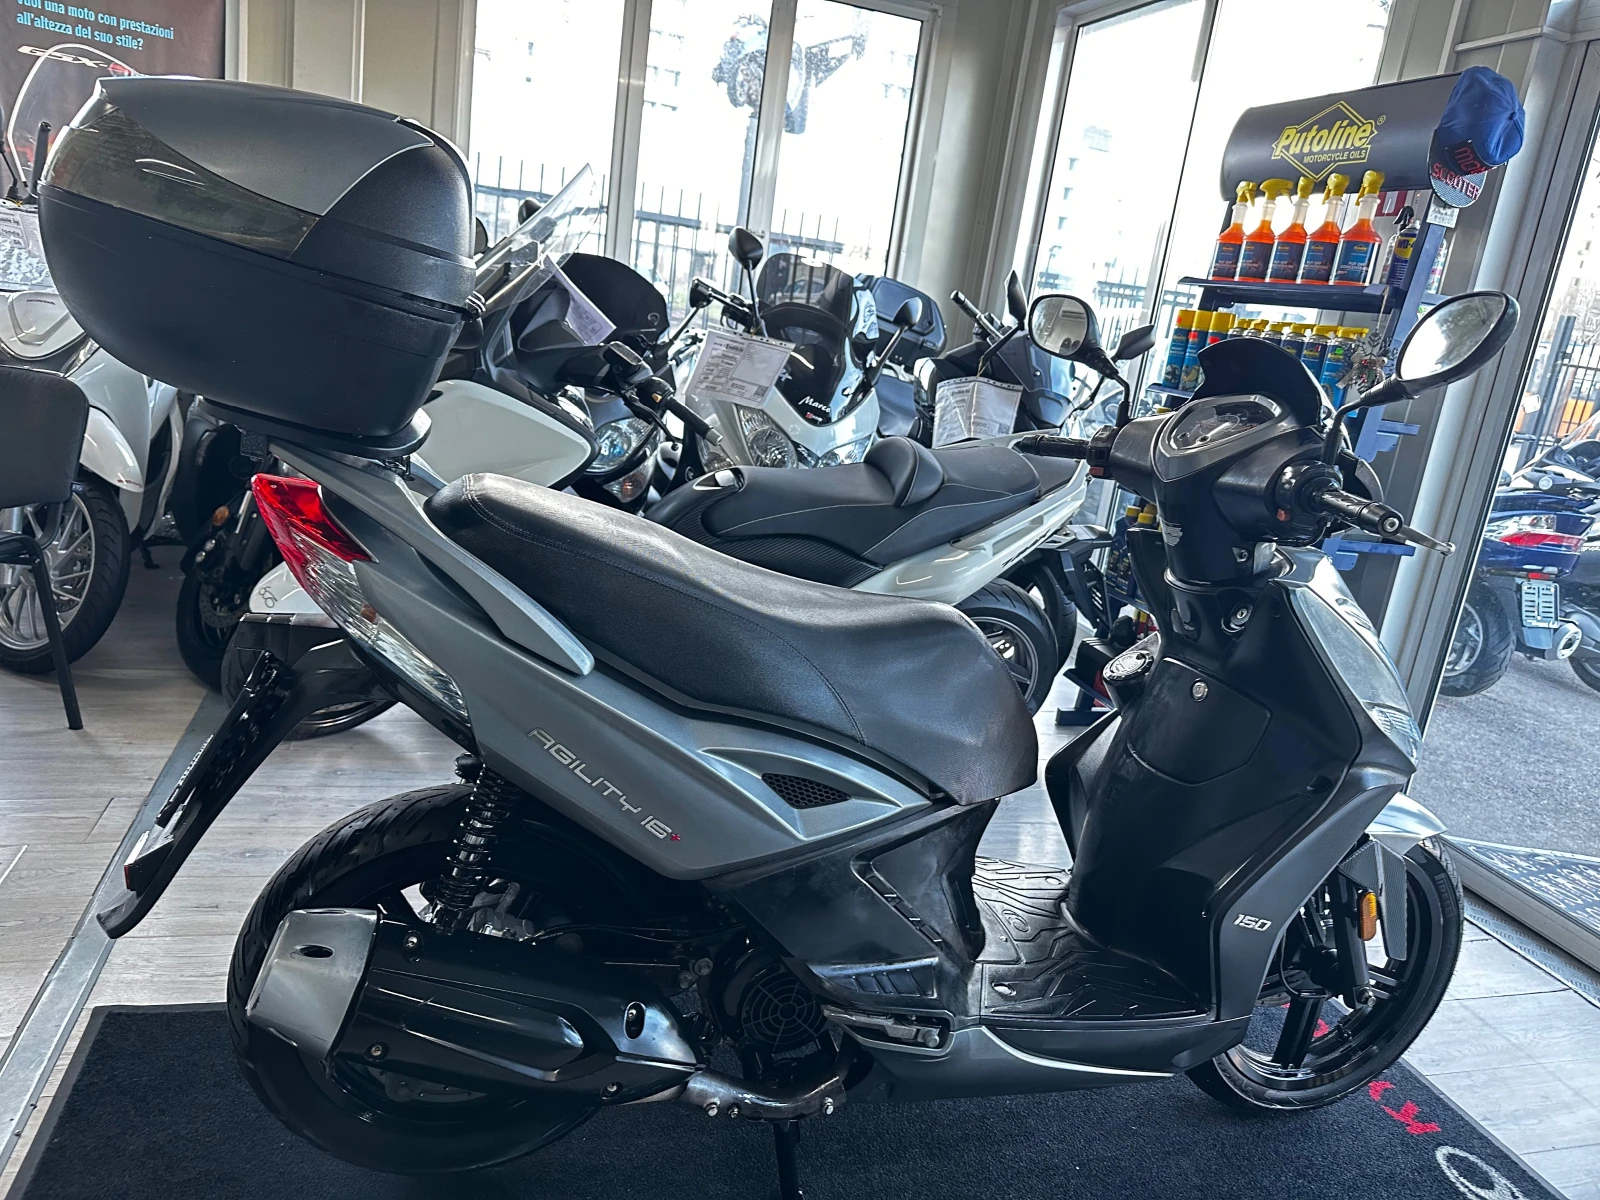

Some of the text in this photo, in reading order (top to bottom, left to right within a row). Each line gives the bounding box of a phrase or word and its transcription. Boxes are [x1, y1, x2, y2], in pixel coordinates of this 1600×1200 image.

[45, 0, 65, 14] una
[68, 8, 95, 21] moto
[98, 12, 117, 27] con
[120, 18, 174, 40] prestazioni
[75, 25, 91, 40] del
[94, 31, 113, 44] suo
[116, 35, 144, 51] stile?
[1274, 119, 1373, 156] Putoline
[1303, 150, 1366, 164] MOTORCYCLE OILS
[527, 727, 642, 814] AGILITY
[1233, 913, 1272, 932] 150
